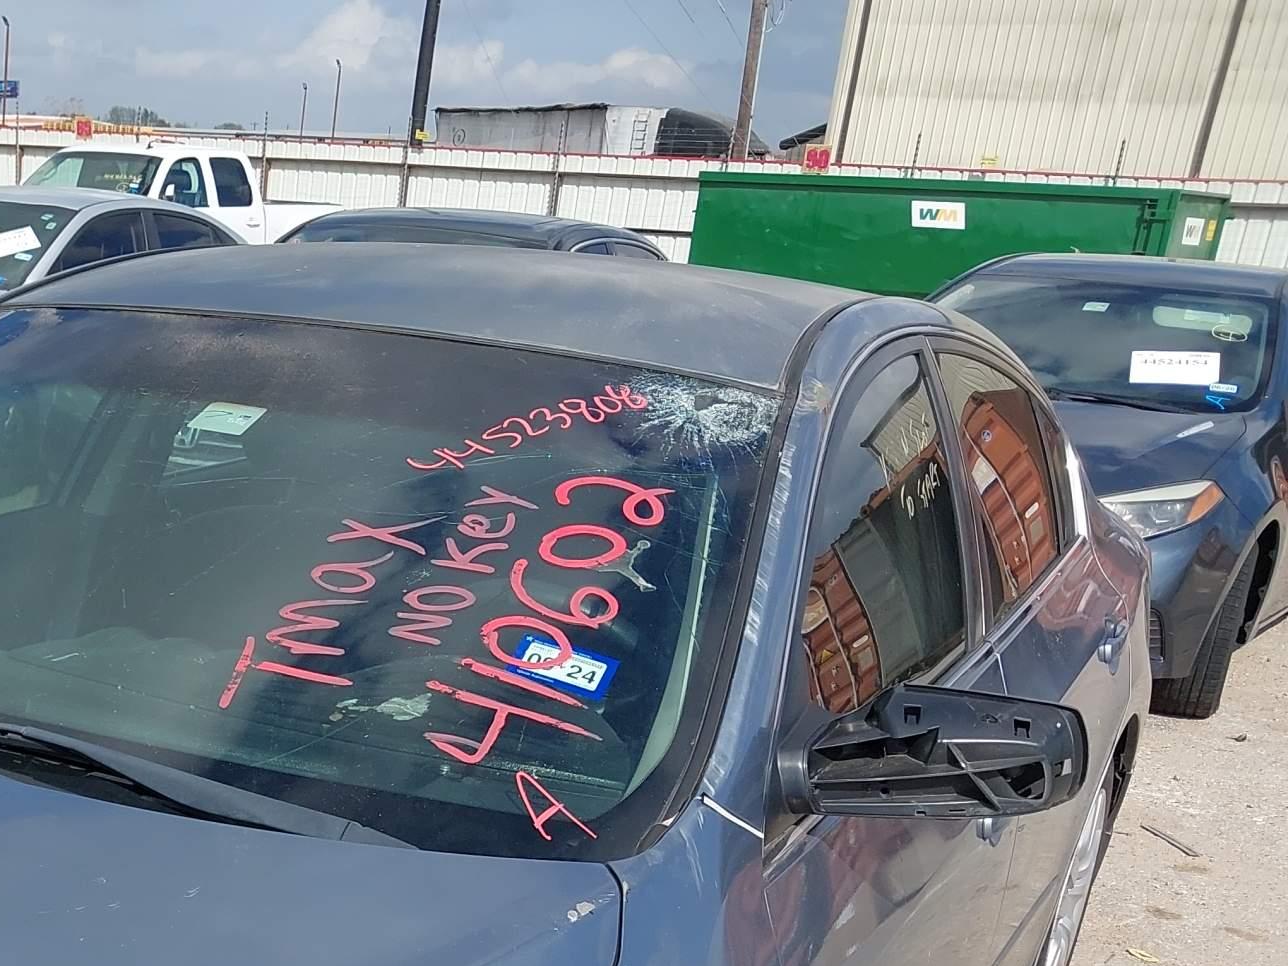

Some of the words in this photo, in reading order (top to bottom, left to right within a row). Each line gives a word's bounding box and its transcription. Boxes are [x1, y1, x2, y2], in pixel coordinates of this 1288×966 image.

[919, 207, 958, 222] WM
[406, 383, 649, 470] 44523808
[423, 475, 676, 765] 410602
[566, 664, 597, 684] 24
[515, 771, 598, 841] A
